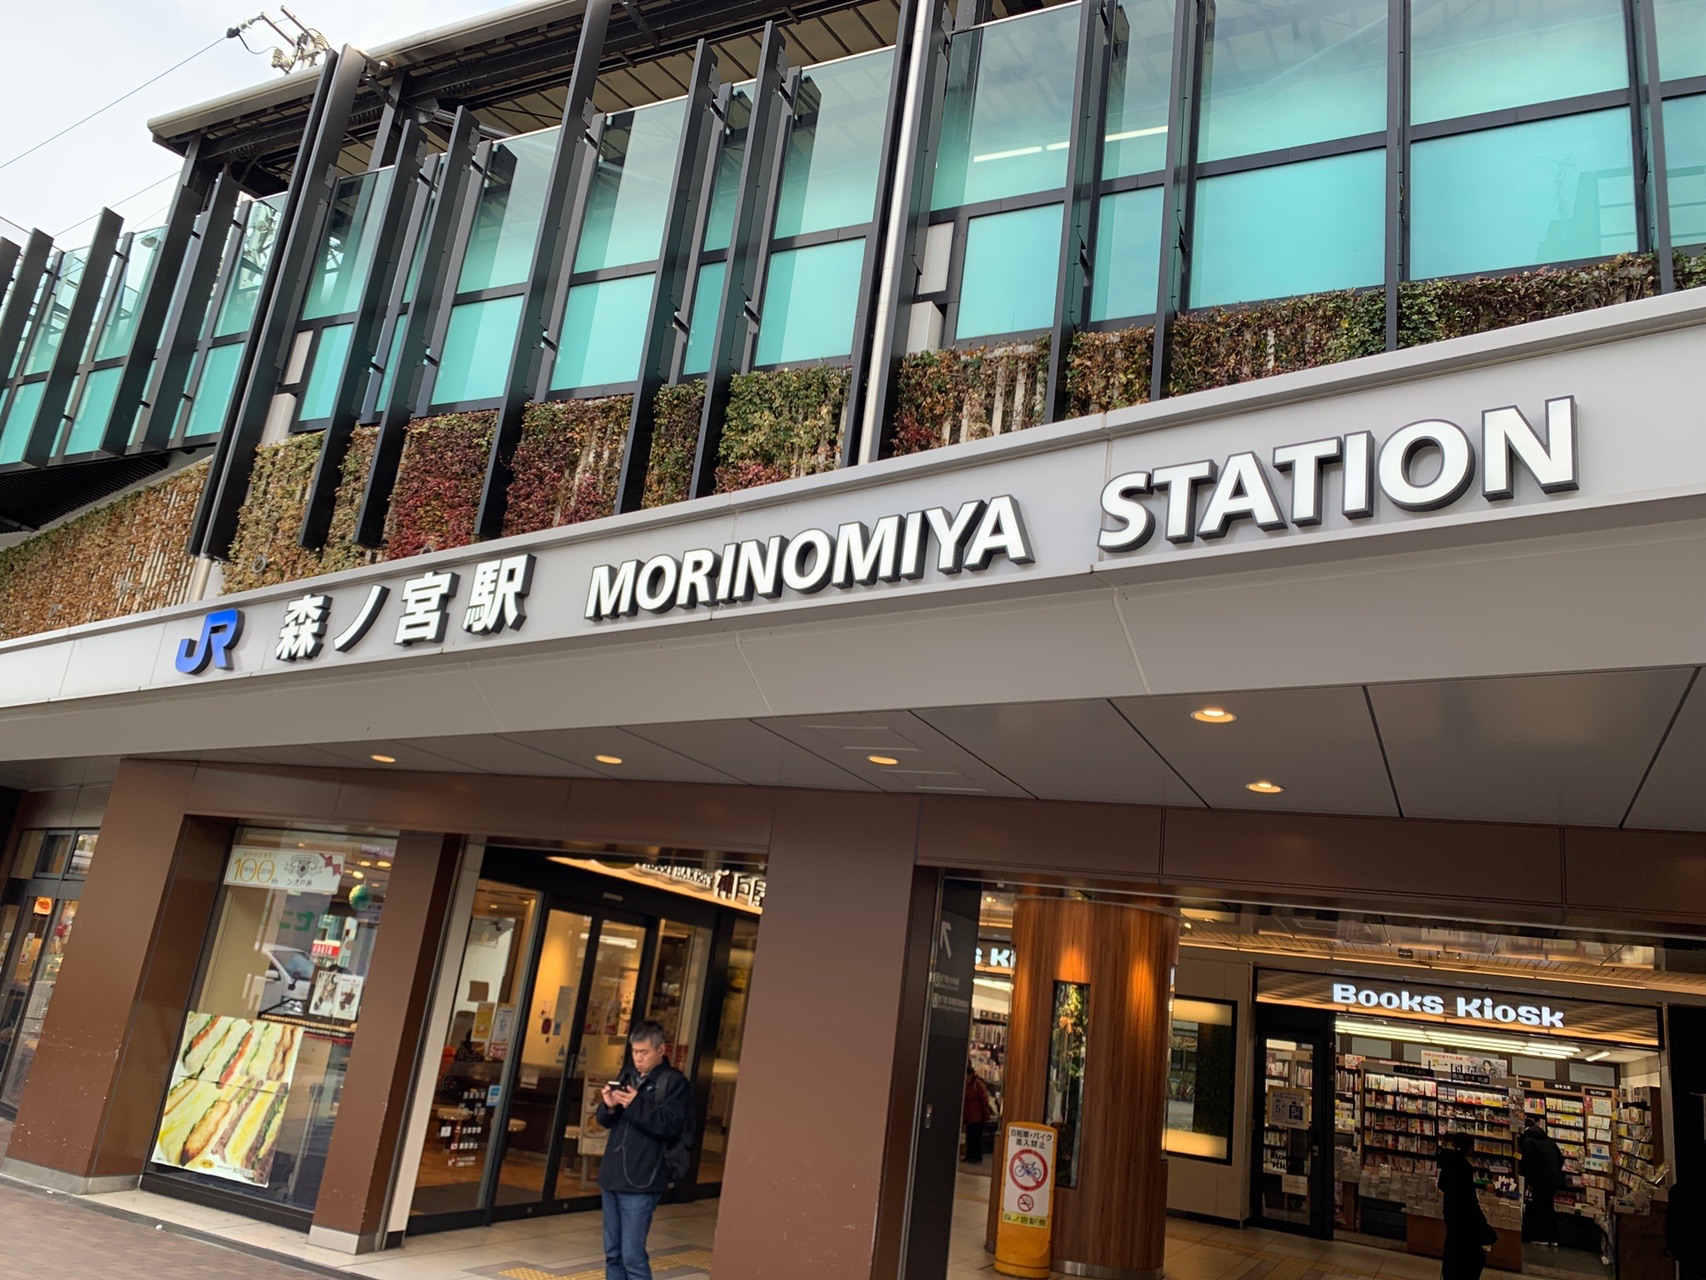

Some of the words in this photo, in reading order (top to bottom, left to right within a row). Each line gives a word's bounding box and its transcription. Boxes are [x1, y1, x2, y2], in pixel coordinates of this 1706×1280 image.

[175, 608, 244, 674] JR
[275, 553, 537, 663] 森ノ宮駅
[584, 494, 1036, 622] MORINOMIYA
[1098, 394, 1580, 552] STATION
[1333, 983, 1444, 1015] Books
[1457, 996, 1564, 1028] Kiosk
